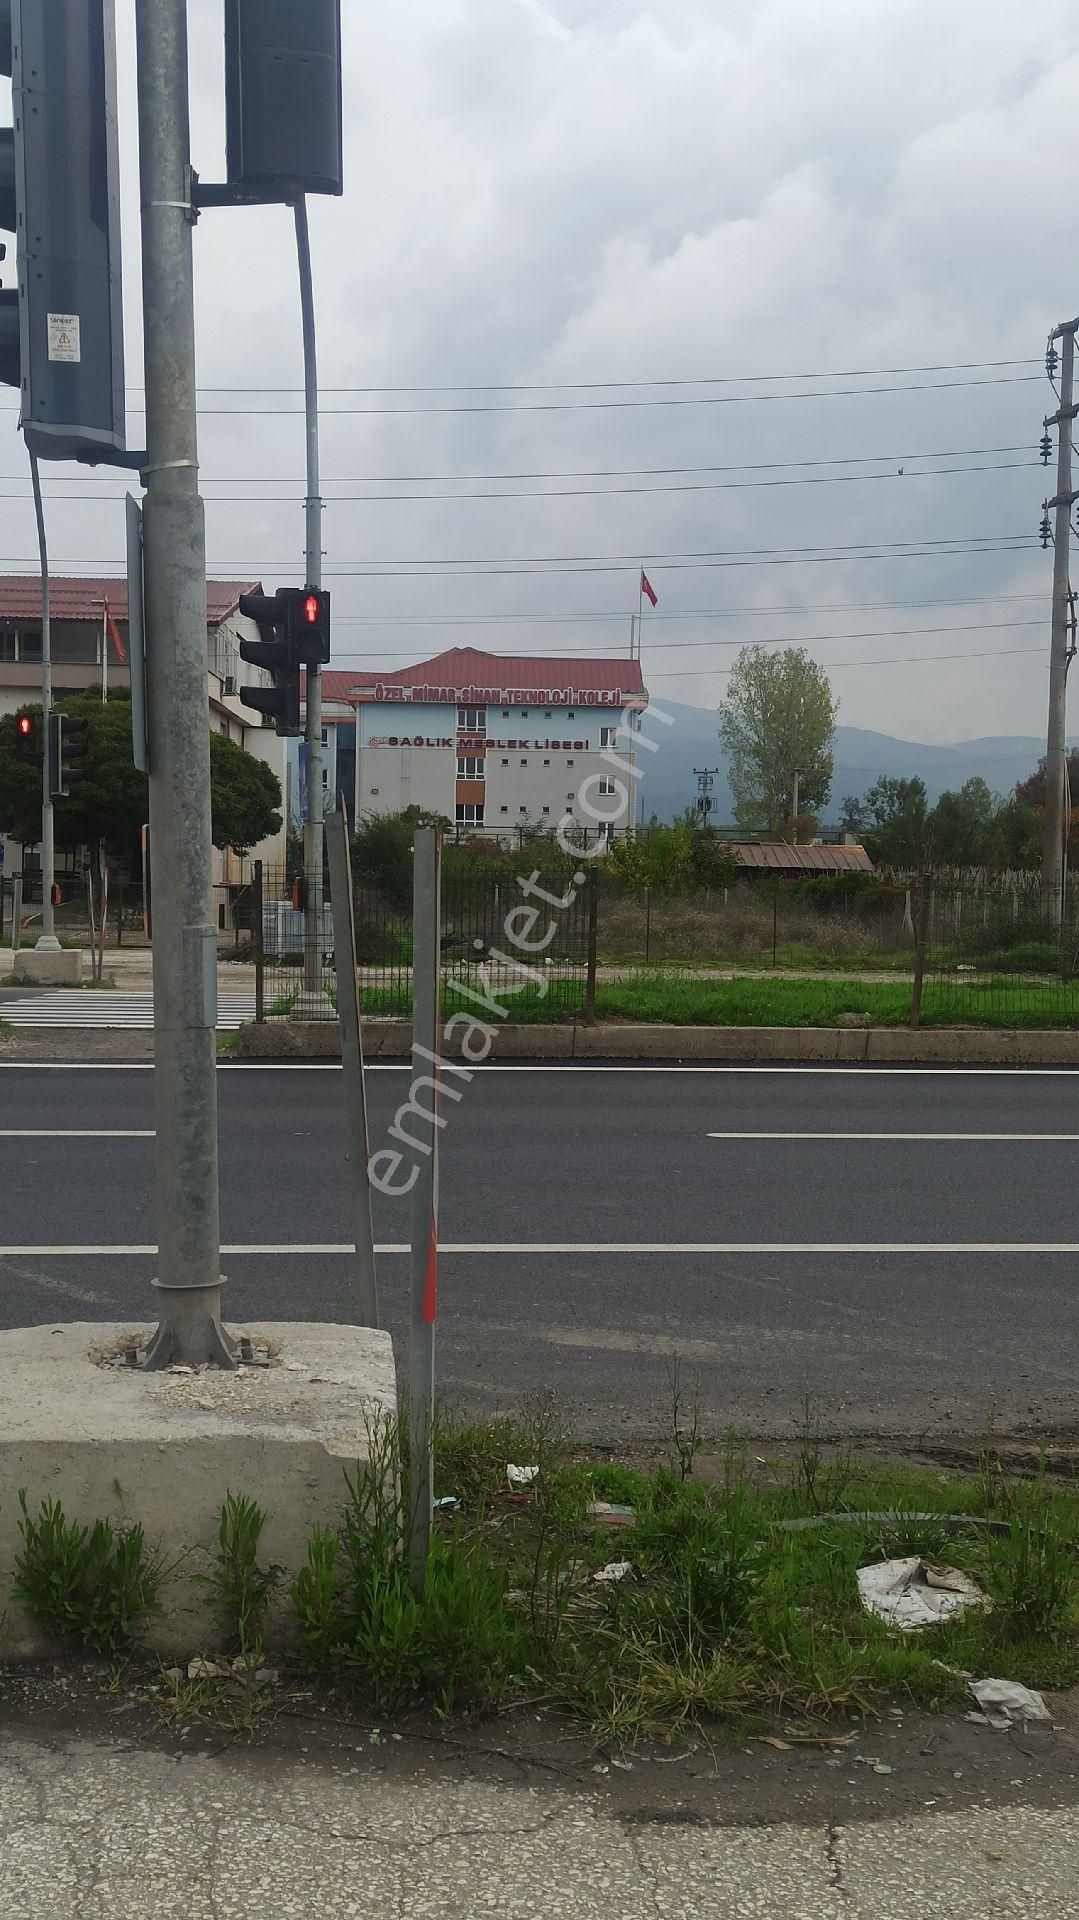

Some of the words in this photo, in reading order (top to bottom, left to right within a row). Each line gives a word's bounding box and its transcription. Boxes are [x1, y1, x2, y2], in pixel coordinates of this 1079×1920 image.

[375, 683, 407, 701] ÖZEL
[411, 684, 457, 703] MİMAR
[460, 685, 502, 704] SİNAN
[506, 687, 574, 705] TEKNOLOJİ
[578, 688, 621, 706] KOLEJİ
[388, 736, 453, 747] SAĞLIK
[461, 738, 530, 749] MESLEK
[535, 739, 589, 750] LİSESİ
